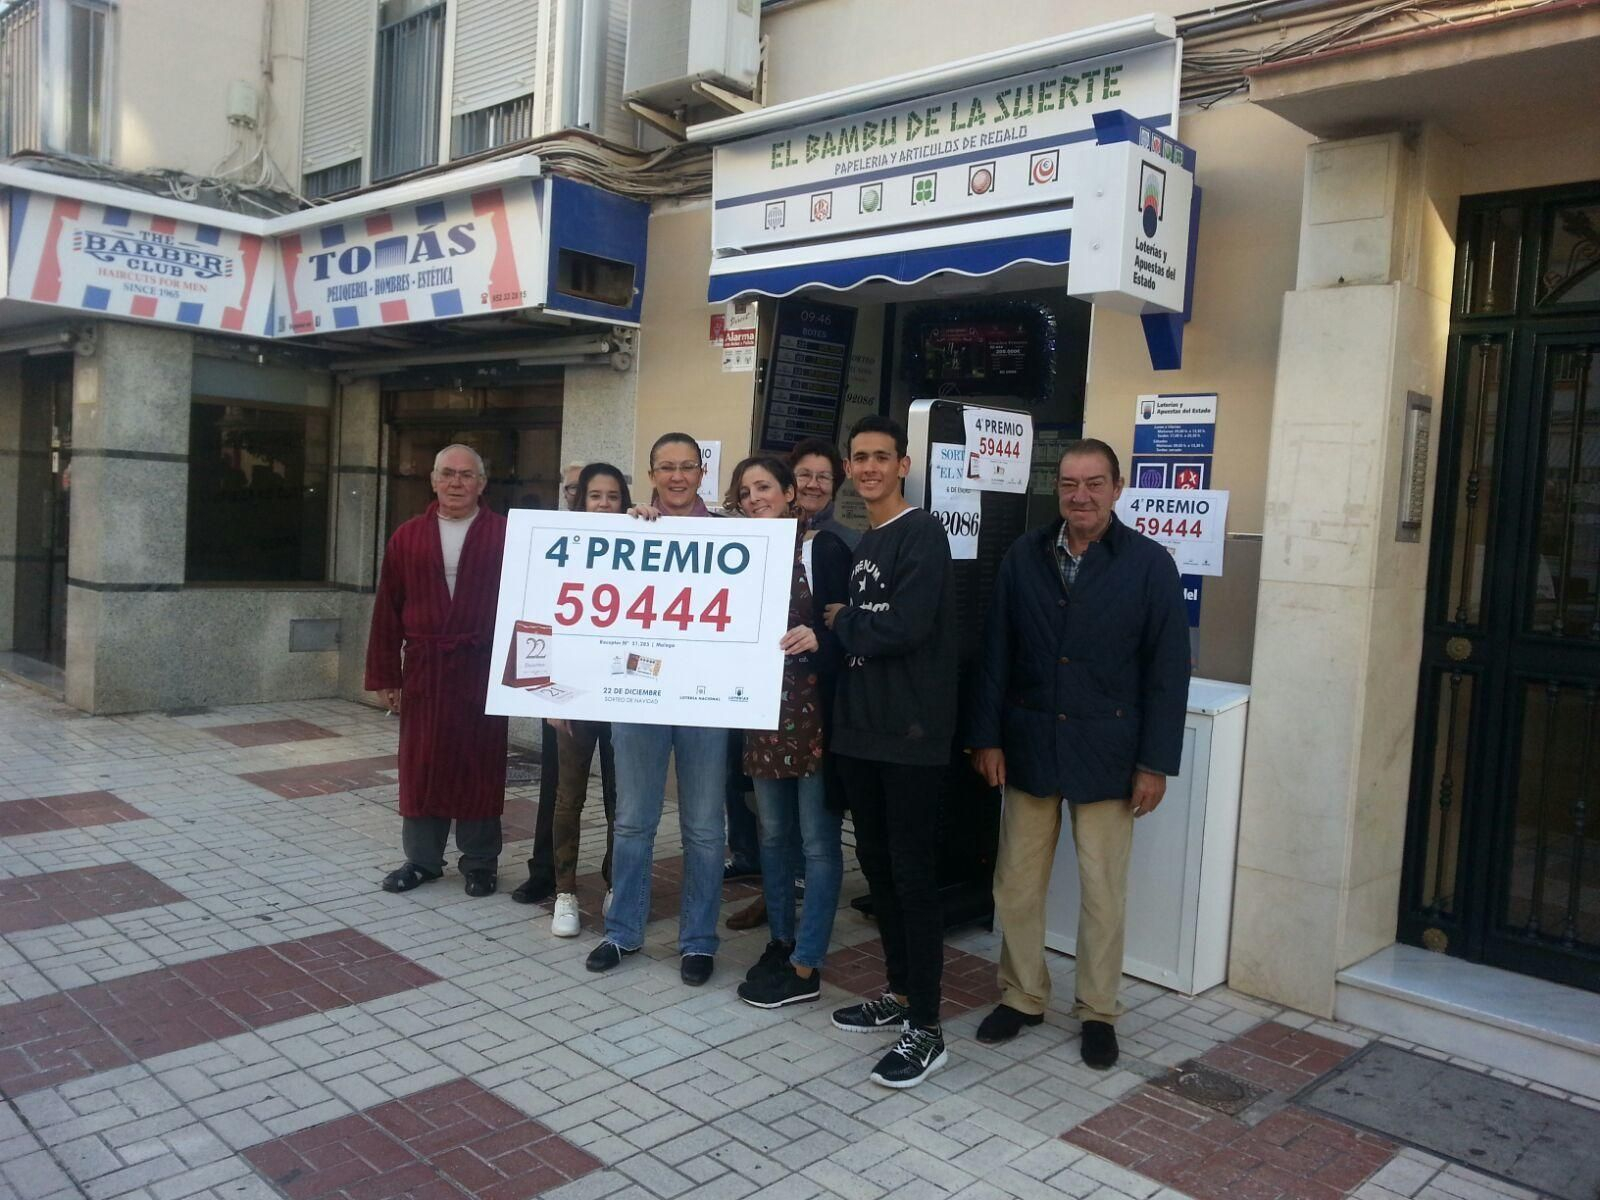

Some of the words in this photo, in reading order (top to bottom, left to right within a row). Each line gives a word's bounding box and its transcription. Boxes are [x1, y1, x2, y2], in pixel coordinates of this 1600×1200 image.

[771, 139, 798, 169] EL
[806, 116, 897, 162] BAMBU
[906, 106, 941, 142] DE
[950, 97, 986, 132] LA
[994, 64, 1123, 124] SUERTE
[835, 153, 889, 175] PAPELERIA
[890, 153, 897, 164] Y
[899, 140, 959, 163] ARTICULOS
[963, 135, 977, 149] DE
[980, 125, 1028, 146] REGALO
[140, 230, 176, 246] THE
[86, 234, 222, 273] BARBER
[309, 222, 477, 281] TOÁS
[1135, 237, 1162, 259] Loterías
[1162, 251, 1168, 264] y
[127, 259, 183, 277] CLUB
[1134, 255, 1165, 277] Apuestas
[1165, 267, 1176, 281] del
[98, 267, 158, 286] HAIRCUTS
[160, 276, 182, 289] FOR
[183, 279, 208, 293] MEN
[123, 282, 156, 297] SINCE
[375, 274, 411, 295] HOMBRES
[1132, 272, 1156, 290] Estado
[726, 331, 754, 342] Alarma
[985, 419, 1024, 437] PREMIO
[979, 437, 1021, 459] 59444
[1145, 499, 1210, 515] PREMIO
[1135, 517, 1203, 538] 59444
[586, 536, 750, 575] PREMIO
[554, 582, 732, 632] 59444
[526, 637, 547, 659] 22
[624, 688, 662, 697] DICIEMBRE
